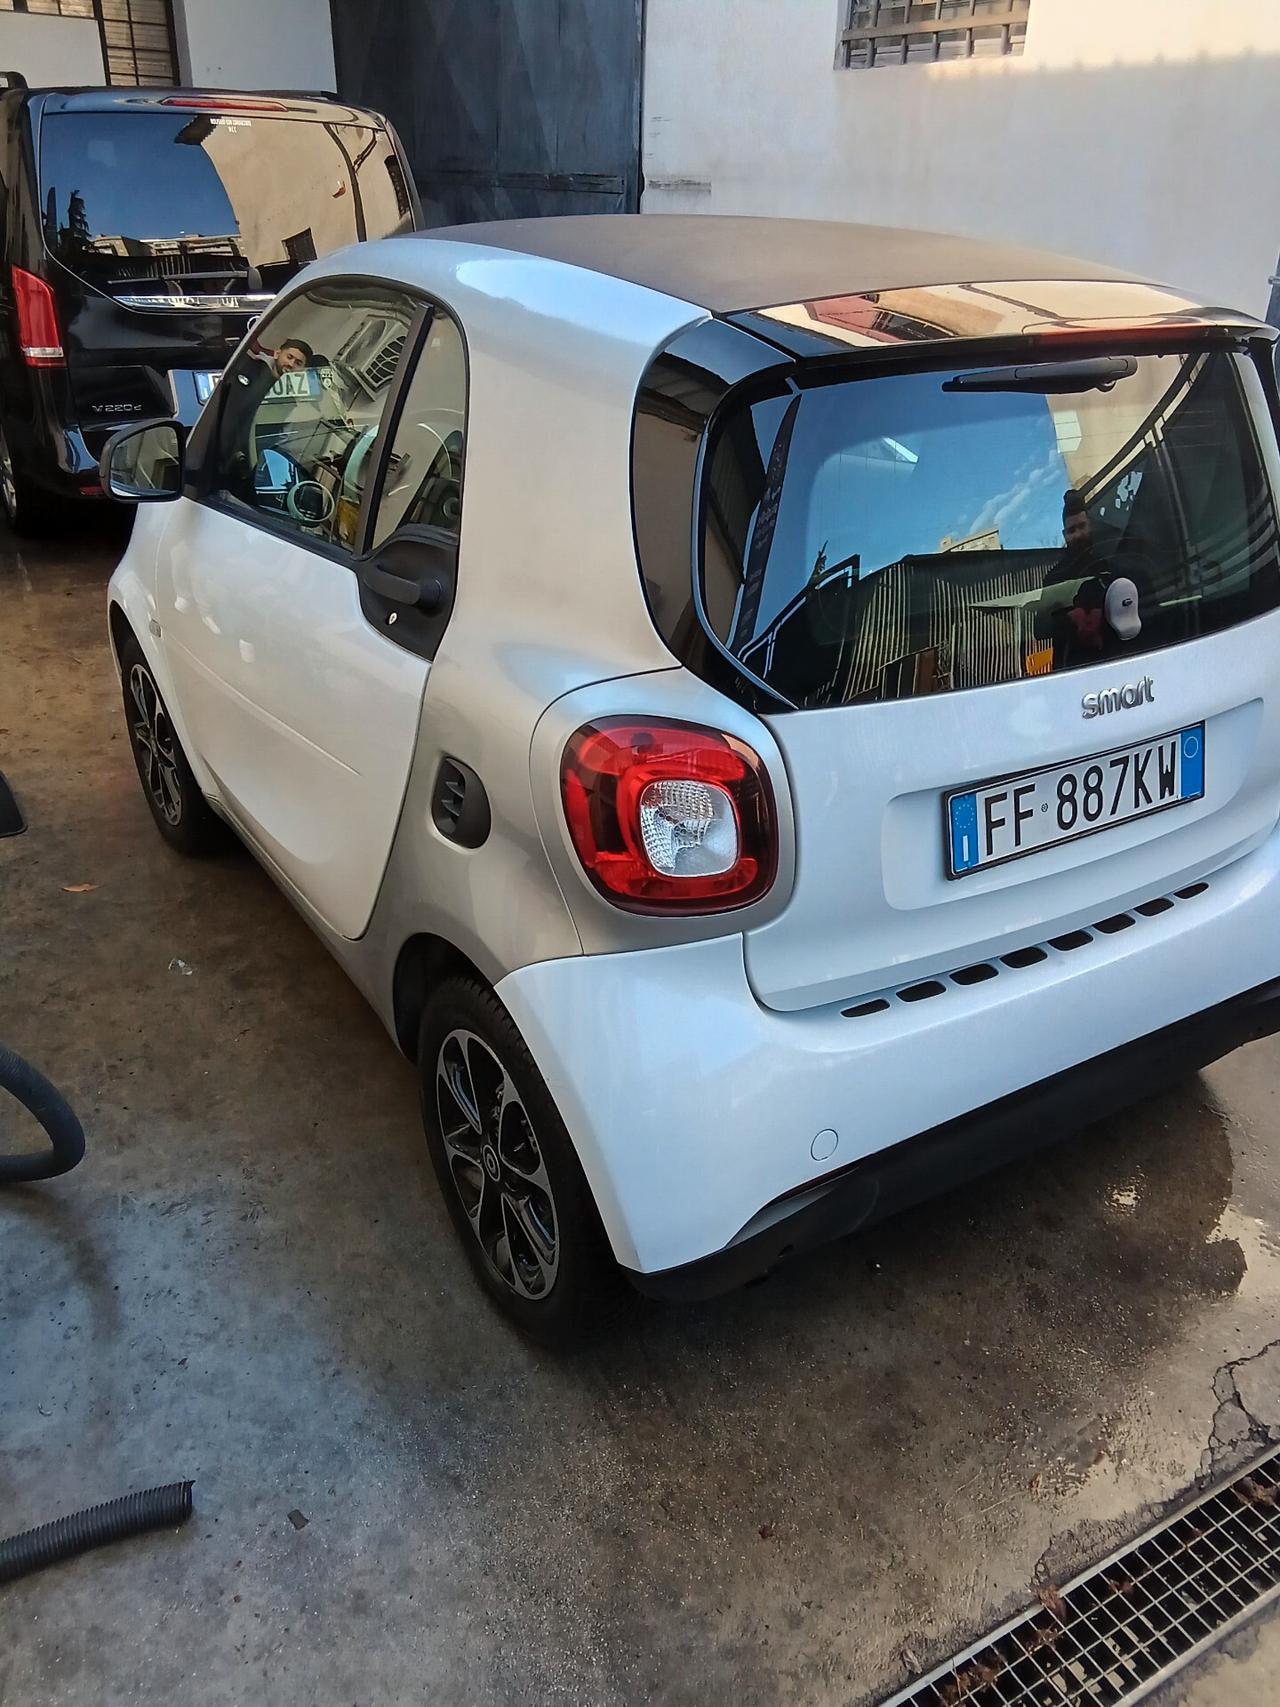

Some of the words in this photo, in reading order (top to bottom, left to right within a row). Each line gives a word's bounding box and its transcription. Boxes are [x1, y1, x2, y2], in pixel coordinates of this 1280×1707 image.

[1081, 675, 1155, 720] smart
[984, 783, 1036, 856] FF
[1056, 740, 1177, 831] 887KW
